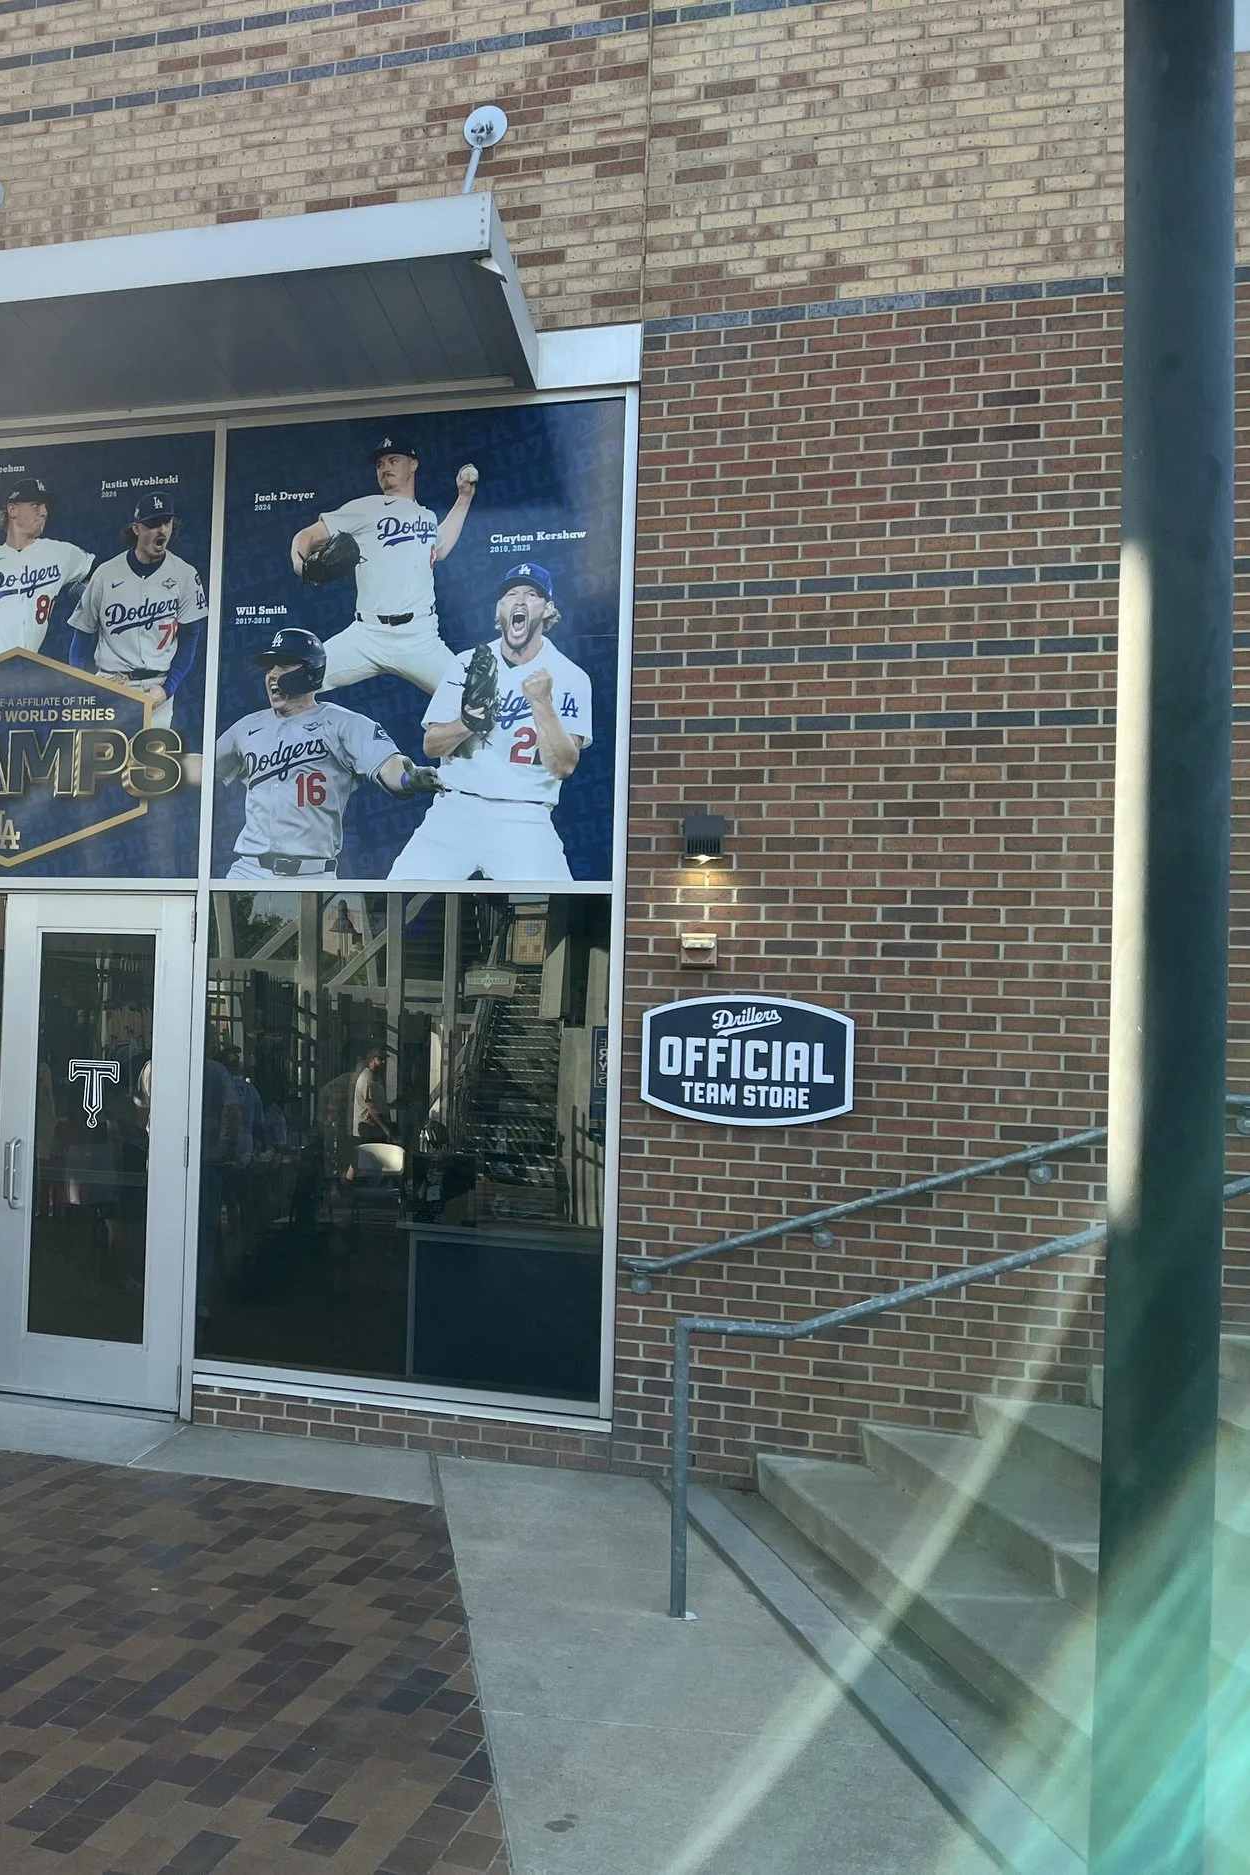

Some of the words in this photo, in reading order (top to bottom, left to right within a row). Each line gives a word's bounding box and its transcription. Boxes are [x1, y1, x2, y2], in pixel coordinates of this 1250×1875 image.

[101, 480, 129, 490] Justin
[131, 475, 179, 486] Wrobleski
[153, 496, 163, 509] LA
[254, 493, 278, 503] Jack
[279, 491, 315, 502] Dreyer
[377, 515, 438, 547] Dodge
[490, 533, 534, 544] Clayton
[536, 530, 587, 541] Kershaw
[512, 543, 531, 552] 2025
[105, 598, 180, 635] Dodgers
[235, 606, 256, 616] Will
[258, 605, 287, 615] Smith
[16, 697, 60, 707] AFFILIATE
[62, 696, 75, 706] OF
[77, 695, 97, 706] THE
[560, 692, 579, 718] LA
[5, 709, 58, 722] WORLD
[61, 708, 115, 721] SERIES
[296, 772, 327, 807] 16
[712, 1006, 782, 1037] Drillers
[659, 1035, 835, 1084] OFFICIAL
[681, 1081, 737, 1106] TEAM
[743, 1085, 810, 1110] STORE
